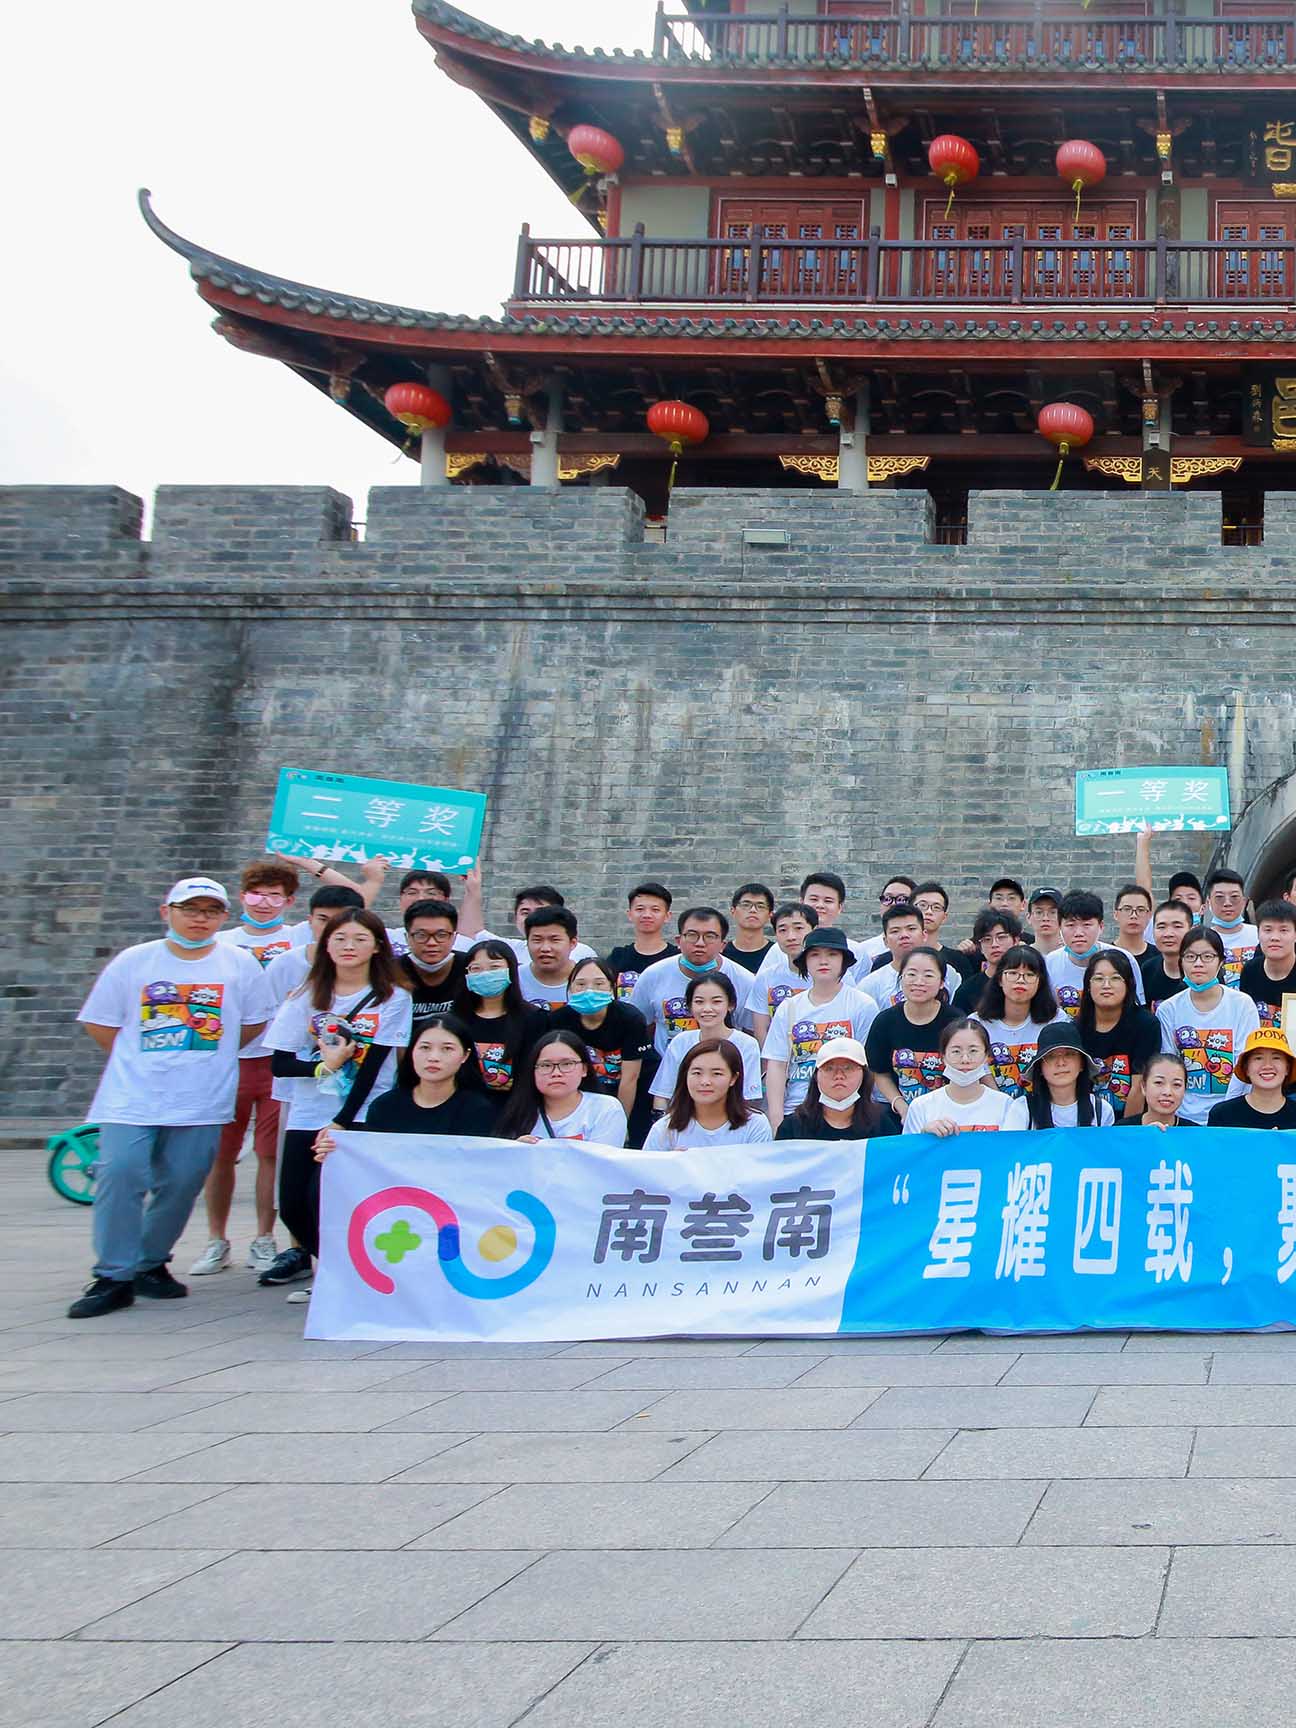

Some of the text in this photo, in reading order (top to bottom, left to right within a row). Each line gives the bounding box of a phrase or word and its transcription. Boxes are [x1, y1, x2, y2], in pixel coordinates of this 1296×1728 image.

[1096, 779, 1210, 803] 一等奖
[300, 794, 460, 836] 二等奖
[143, 1029, 188, 1049] NSN!
[1186, 1073, 1207, 1090] SN!
[593, 1186, 837, 1265] 南叁南
[585, 1275, 824, 1299] NANSANNAN
